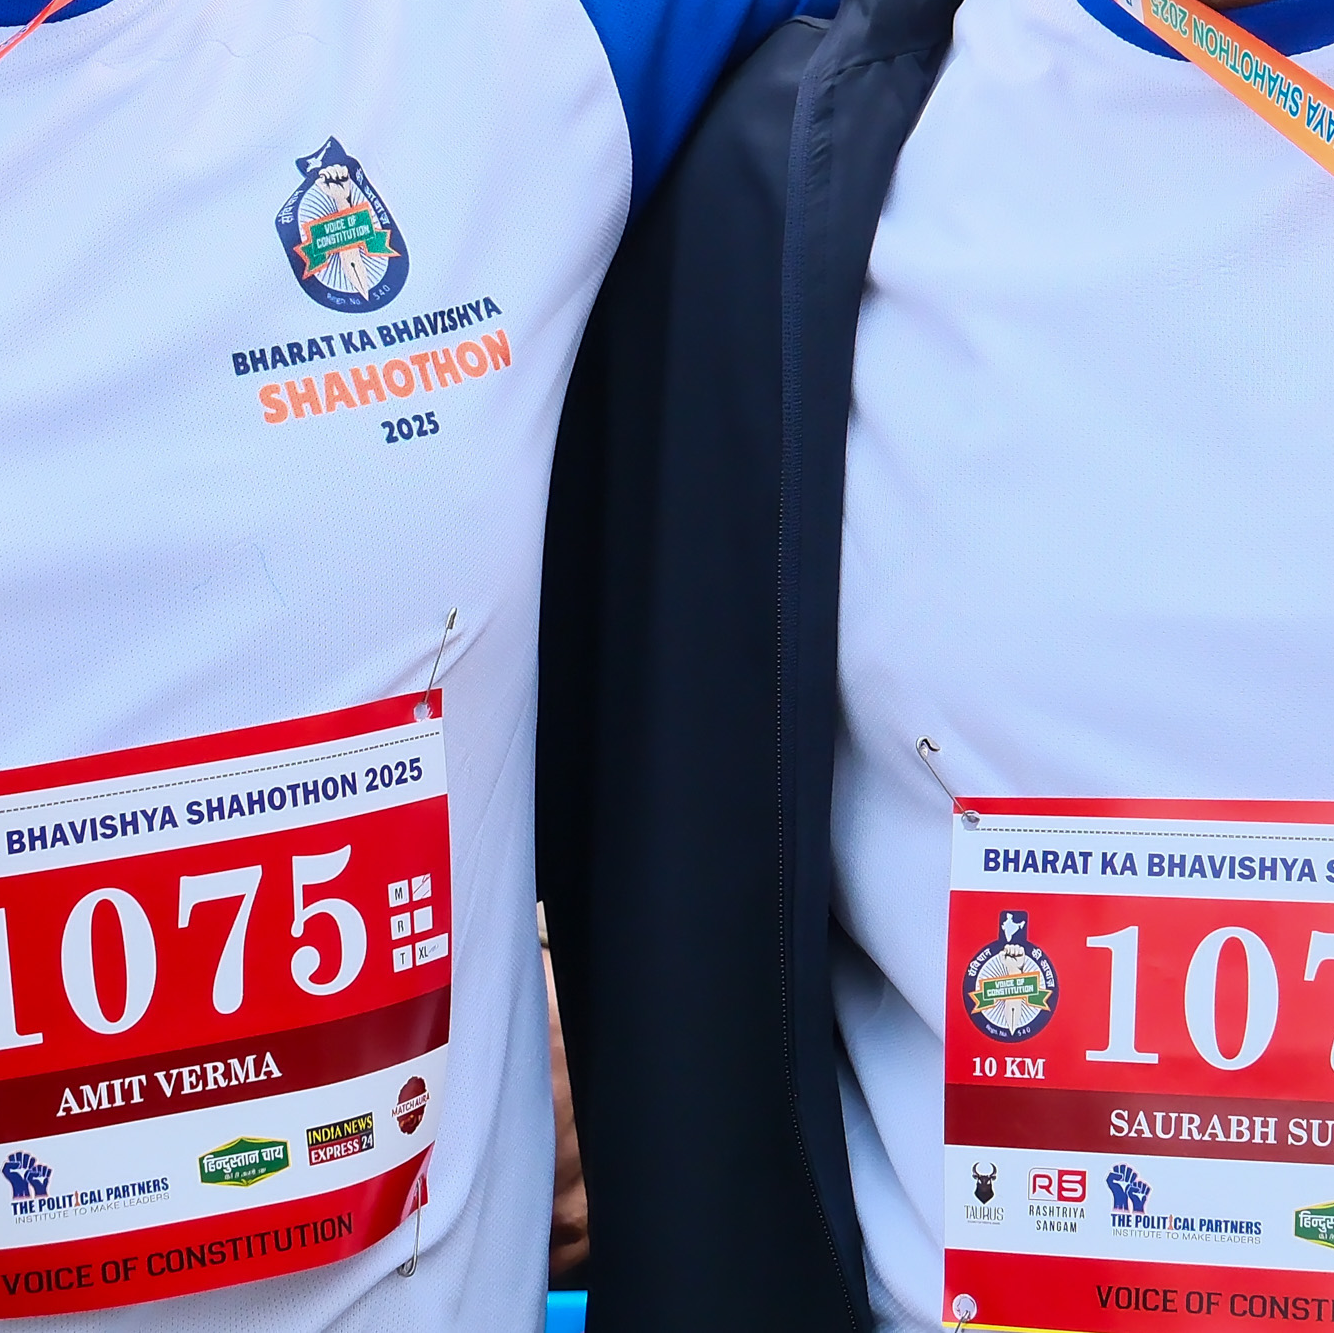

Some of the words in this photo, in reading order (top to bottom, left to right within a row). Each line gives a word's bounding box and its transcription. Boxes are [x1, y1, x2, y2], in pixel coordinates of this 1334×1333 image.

[1192, 15, 1304, 118] SHAHOTHON
[316, 224, 371, 249] CONSTITUTION
[324, 218, 345, 234] VOICE
[347, 215, 357, 227] OF
[373, 285, 391, 300] 540
[232, 334, 336, 377] BHARAT
[339, 328, 377, 355] KA
[378, 296, 503, 347] BHAVISHYA
[258, 328, 513, 424] SHAHOTHON
[380, 411, 440, 444] 2025
[6, 805, 179, 857] BHAVISHYA
[186, 776, 359, 827] SHAHOTHON
[364, 757, 423, 793] 2025
[983, 847, 1093, 876] BHARAT
[1100, 852, 1138, 876] KA
[1146, 853, 1318, 884] BHAVISHYA
[394, 887, 403, 900] M
[397, 920, 404, 933] R
[400, 952, 405, 965] T
[418, 946, 428, 960] XL
[986, 985, 1034, 997] CONSTITUTION
[995, 980, 1014, 989] VOICE
[1016, 978, 1025, 986] OF
[1017, 1027, 1031, 1036] 540
[972, 1057, 997, 1077] 10
[1004, 1057, 1046, 1079] KM
[56, 1074, 147, 1117] AMIT
[150, 1050, 283, 1099] VERMA
[308, 1125, 342, 1145] INDIA
[344, 1115, 373, 1134] NEWS
[1109, 1109, 1278, 1146] SAURABH
[203, 1149, 260, 1174] हिन्दुस्तान
[262, 1145, 284, 1161] चाय
[311, 1141, 360, 1164] EXPRESS
[361, 1134, 373, 1149] 24
[11, 1200, 35, 1215] THE
[106, 1177, 169, 1201] PARTNERS
[15, 1209, 69, 1224] INSTITUTE
[73, 1208, 87, 1216] TO
[90, 1201, 120, 1213] MAKE
[123, 1193, 170, 1208] LEADERS
[964, 1205, 1004, 1221] TAURUS
[1029, 1204, 1085, 1219] RASHTRIYA
[1111, 1214, 1132, 1227] THE
[1199, 1219, 1262, 1235] PARTNERS
[1036, 1220, 1077, 1233] SANGAM
[1112, 1229, 1162, 1238] INSTITUTE
[1167, 1231, 1179, 1240] TO
[1182, 1233, 1211, 1242] MAKE
[1215, 1234, 1261, 1244] LEADERS
[1, 1263, 94, 1297] VOICE
[100, 1256, 139, 1284] OF
[145, 1211, 355, 1279] CONSTITUTION
[1095, 1284, 1177, 1314] VOICE
[1184, 1290, 1222, 1317] OF
